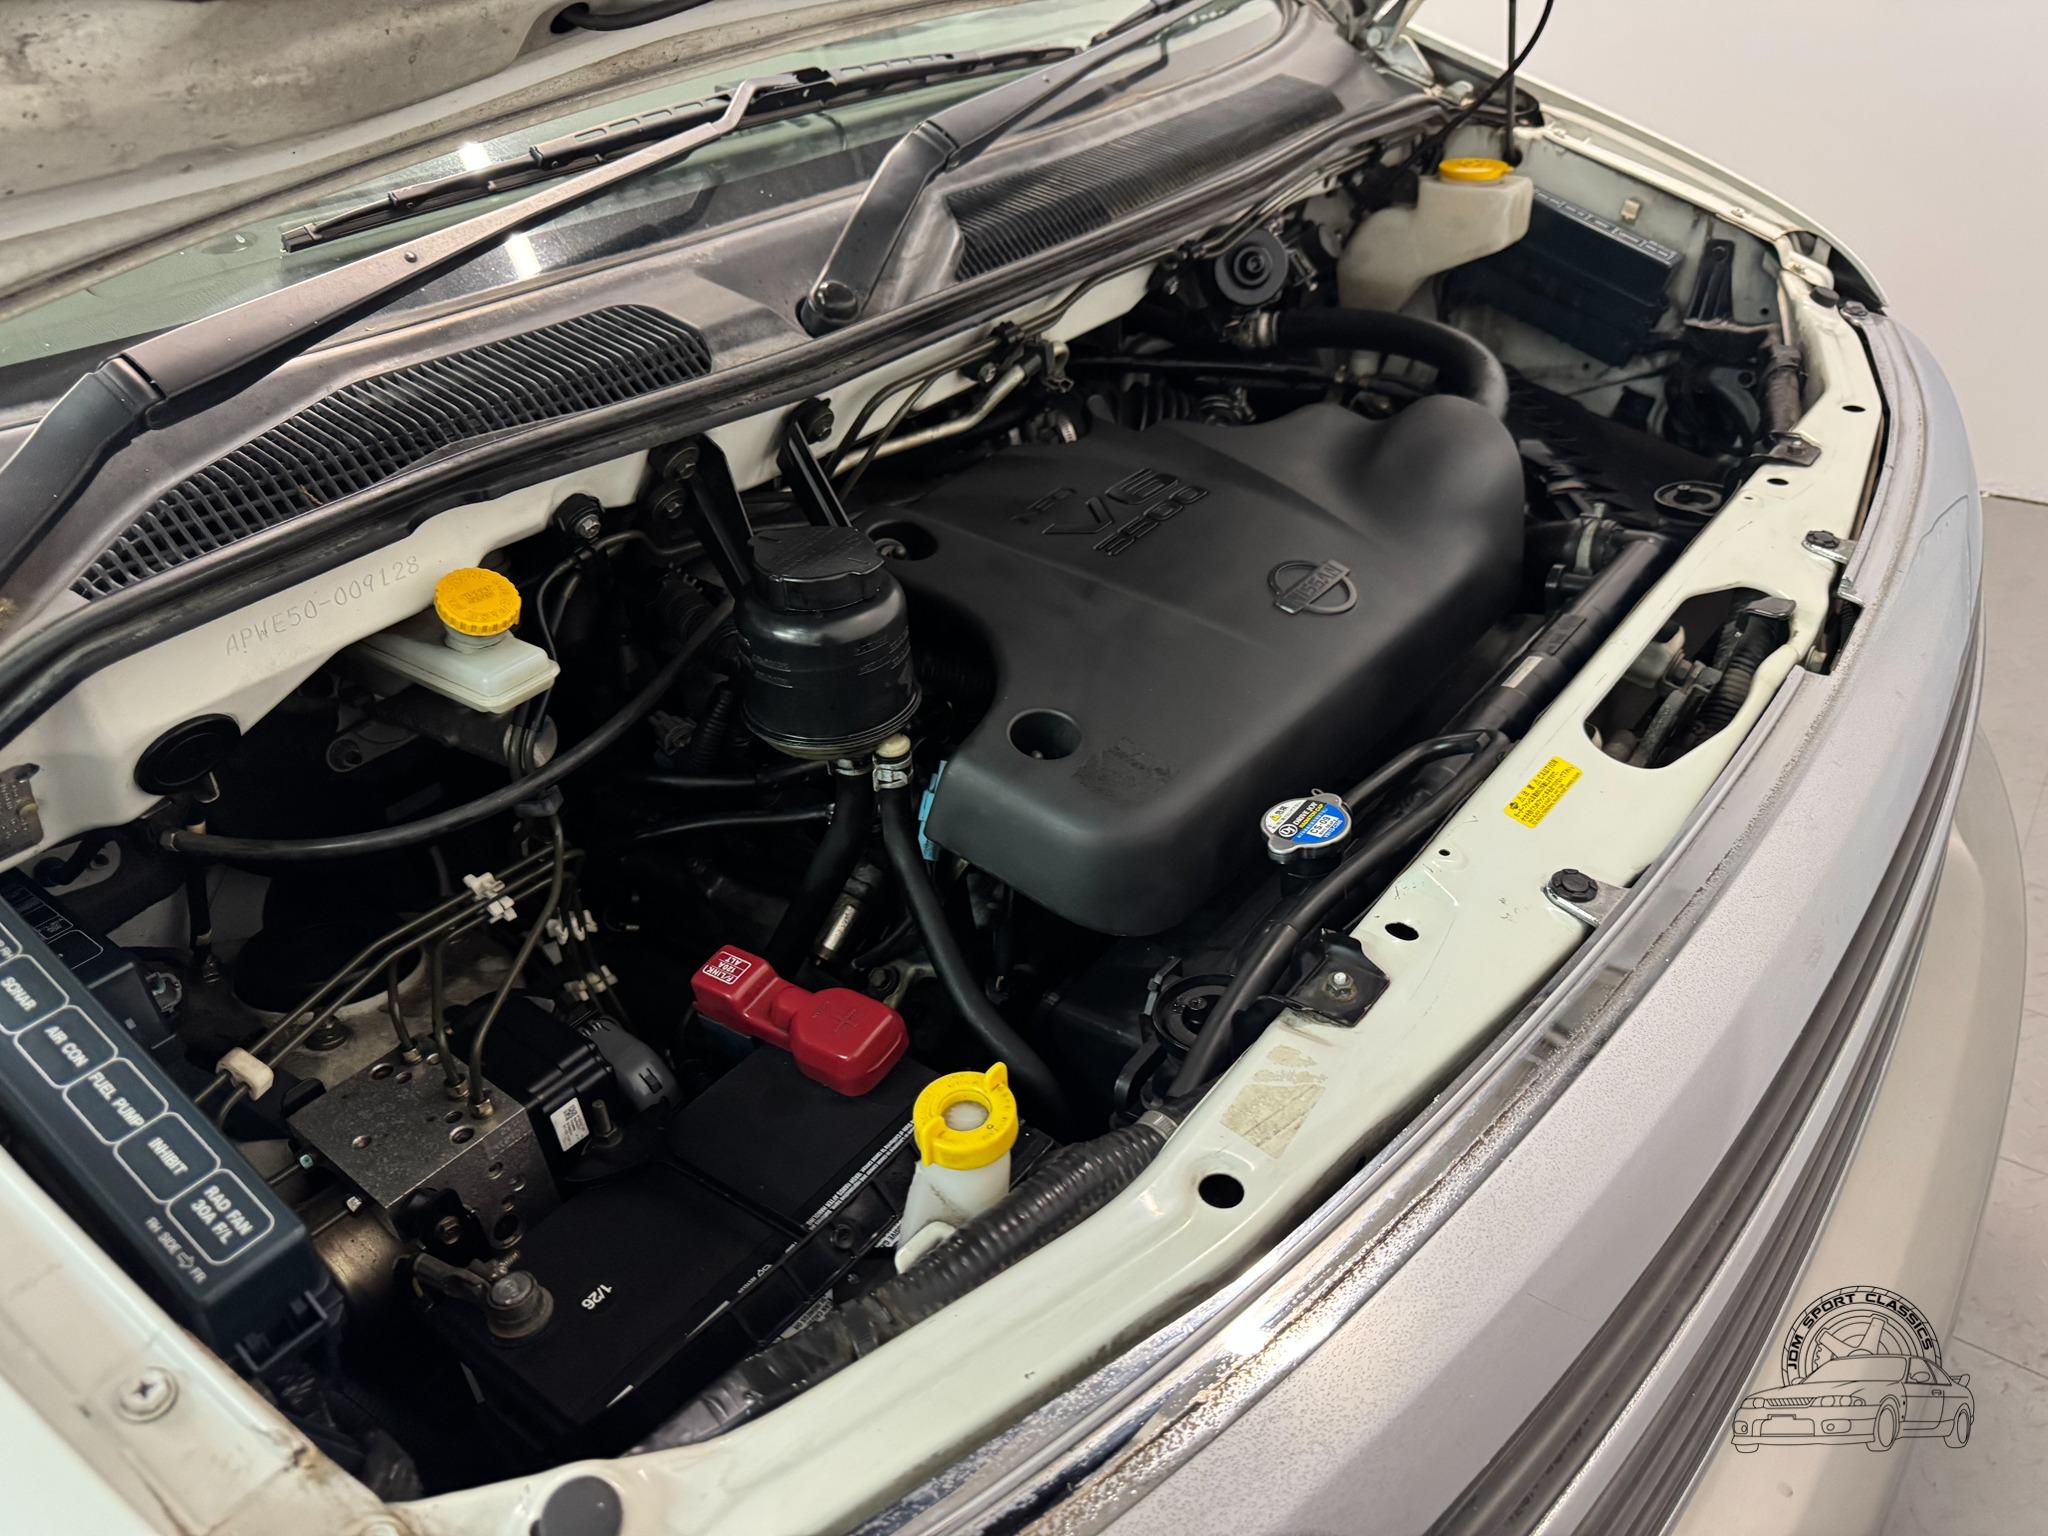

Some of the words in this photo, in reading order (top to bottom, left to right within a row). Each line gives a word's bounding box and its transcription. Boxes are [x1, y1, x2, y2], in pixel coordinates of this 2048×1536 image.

[1042, 468, 1181, 534] V6
[1283, 563, 1344, 606] NISSAN
[707, 966, 733, 982] F/LINK
[717, 961, 736, 973] 120A
[724, 956, 741, 966] ALT
[1, 976, 37, 1012] SONAR
[43, 1025, 69, 1045] AIR
[61, 1042, 89, 1068] CON
[87, 1071, 117, 1101] FUEL
[111, 1097, 145, 1127] PUMP
[147, 1137, 188, 1176] INHIBIT
[190, 1199, 217, 1226] 30A
[211, 1221, 234, 1245] F/L
[203, 1185, 231, 1212] RAD
[226, 1209, 254, 1236] FAN
[581, 1284, 612, 1310] 1/26
